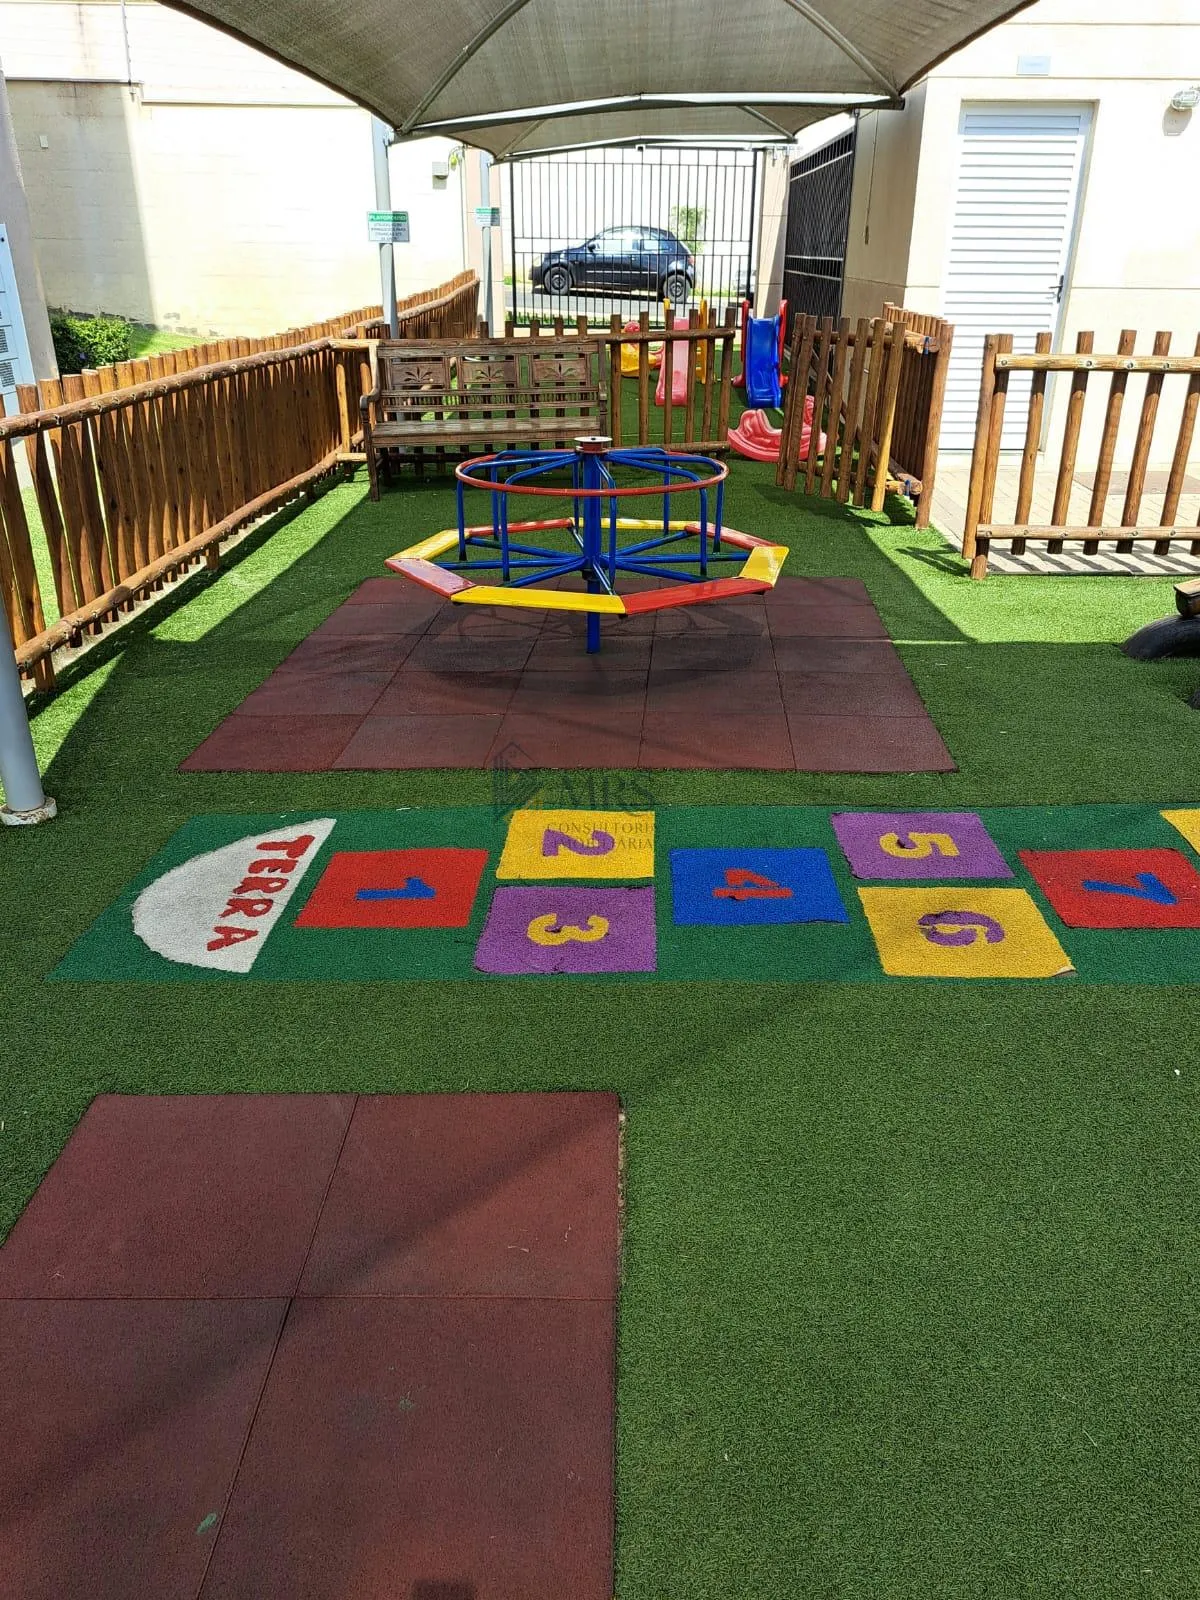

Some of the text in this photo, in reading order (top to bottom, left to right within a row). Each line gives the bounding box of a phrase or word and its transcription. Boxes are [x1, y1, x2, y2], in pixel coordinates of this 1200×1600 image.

[541, 828, 616, 857] 2
[879, 832, 960, 859] 5
[206, 834, 315, 952] TERRA
[355, 876, 436, 901] 1
[712, 868, 794, 898] 4
[527, 912, 610, 946] 3
